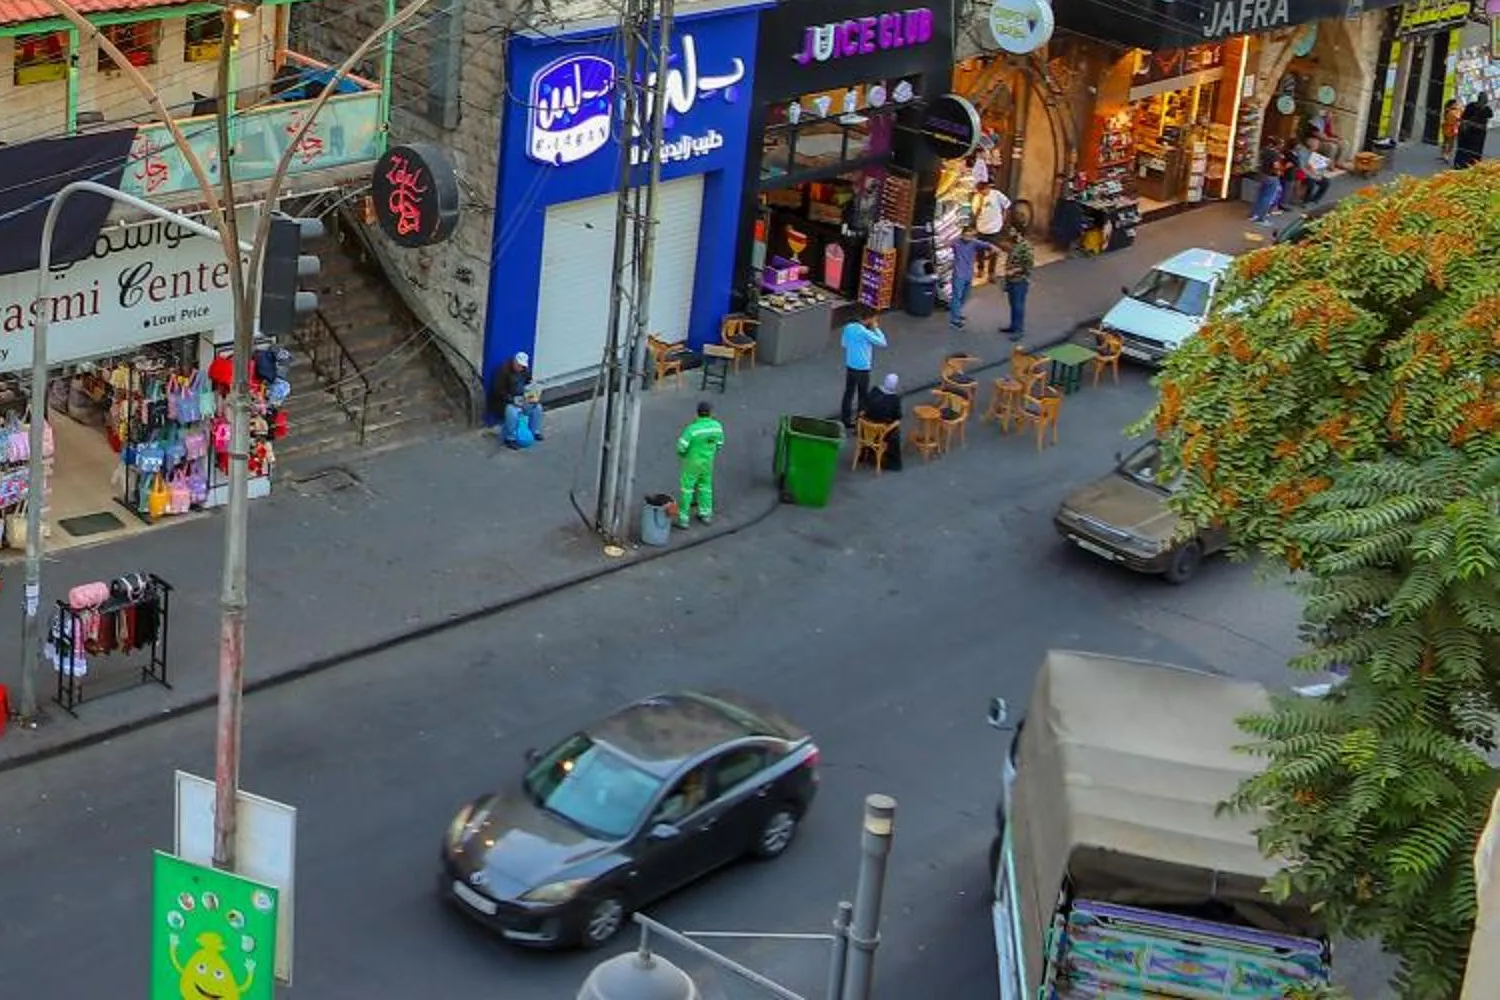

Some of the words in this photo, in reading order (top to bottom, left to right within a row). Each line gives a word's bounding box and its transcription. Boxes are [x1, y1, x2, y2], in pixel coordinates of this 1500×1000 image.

[791, 16, 877, 66] JUICE
[878, 7, 934, 49] CLUB
[118, 257, 249, 310] Cente
[152, 312, 179, 328] Low
[182, 304, 211, 322] Price
